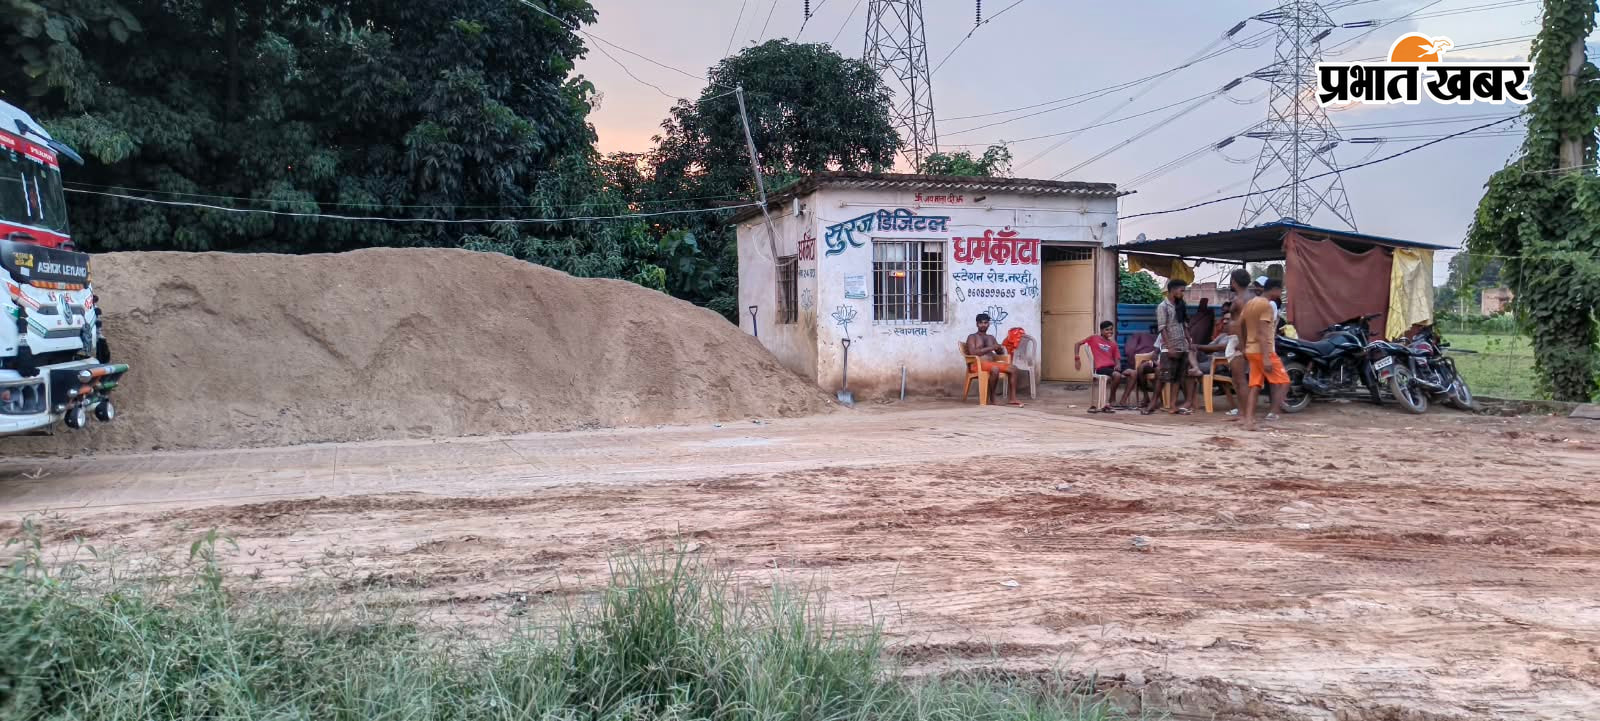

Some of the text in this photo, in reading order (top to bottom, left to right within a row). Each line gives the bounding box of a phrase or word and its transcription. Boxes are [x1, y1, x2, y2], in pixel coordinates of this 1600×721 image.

[877, 208, 951, 232] डिजिटल
[38, 261, 87, 278] ASHOK LEYLAND
[952, 268, 984, 283] स्टेशन
